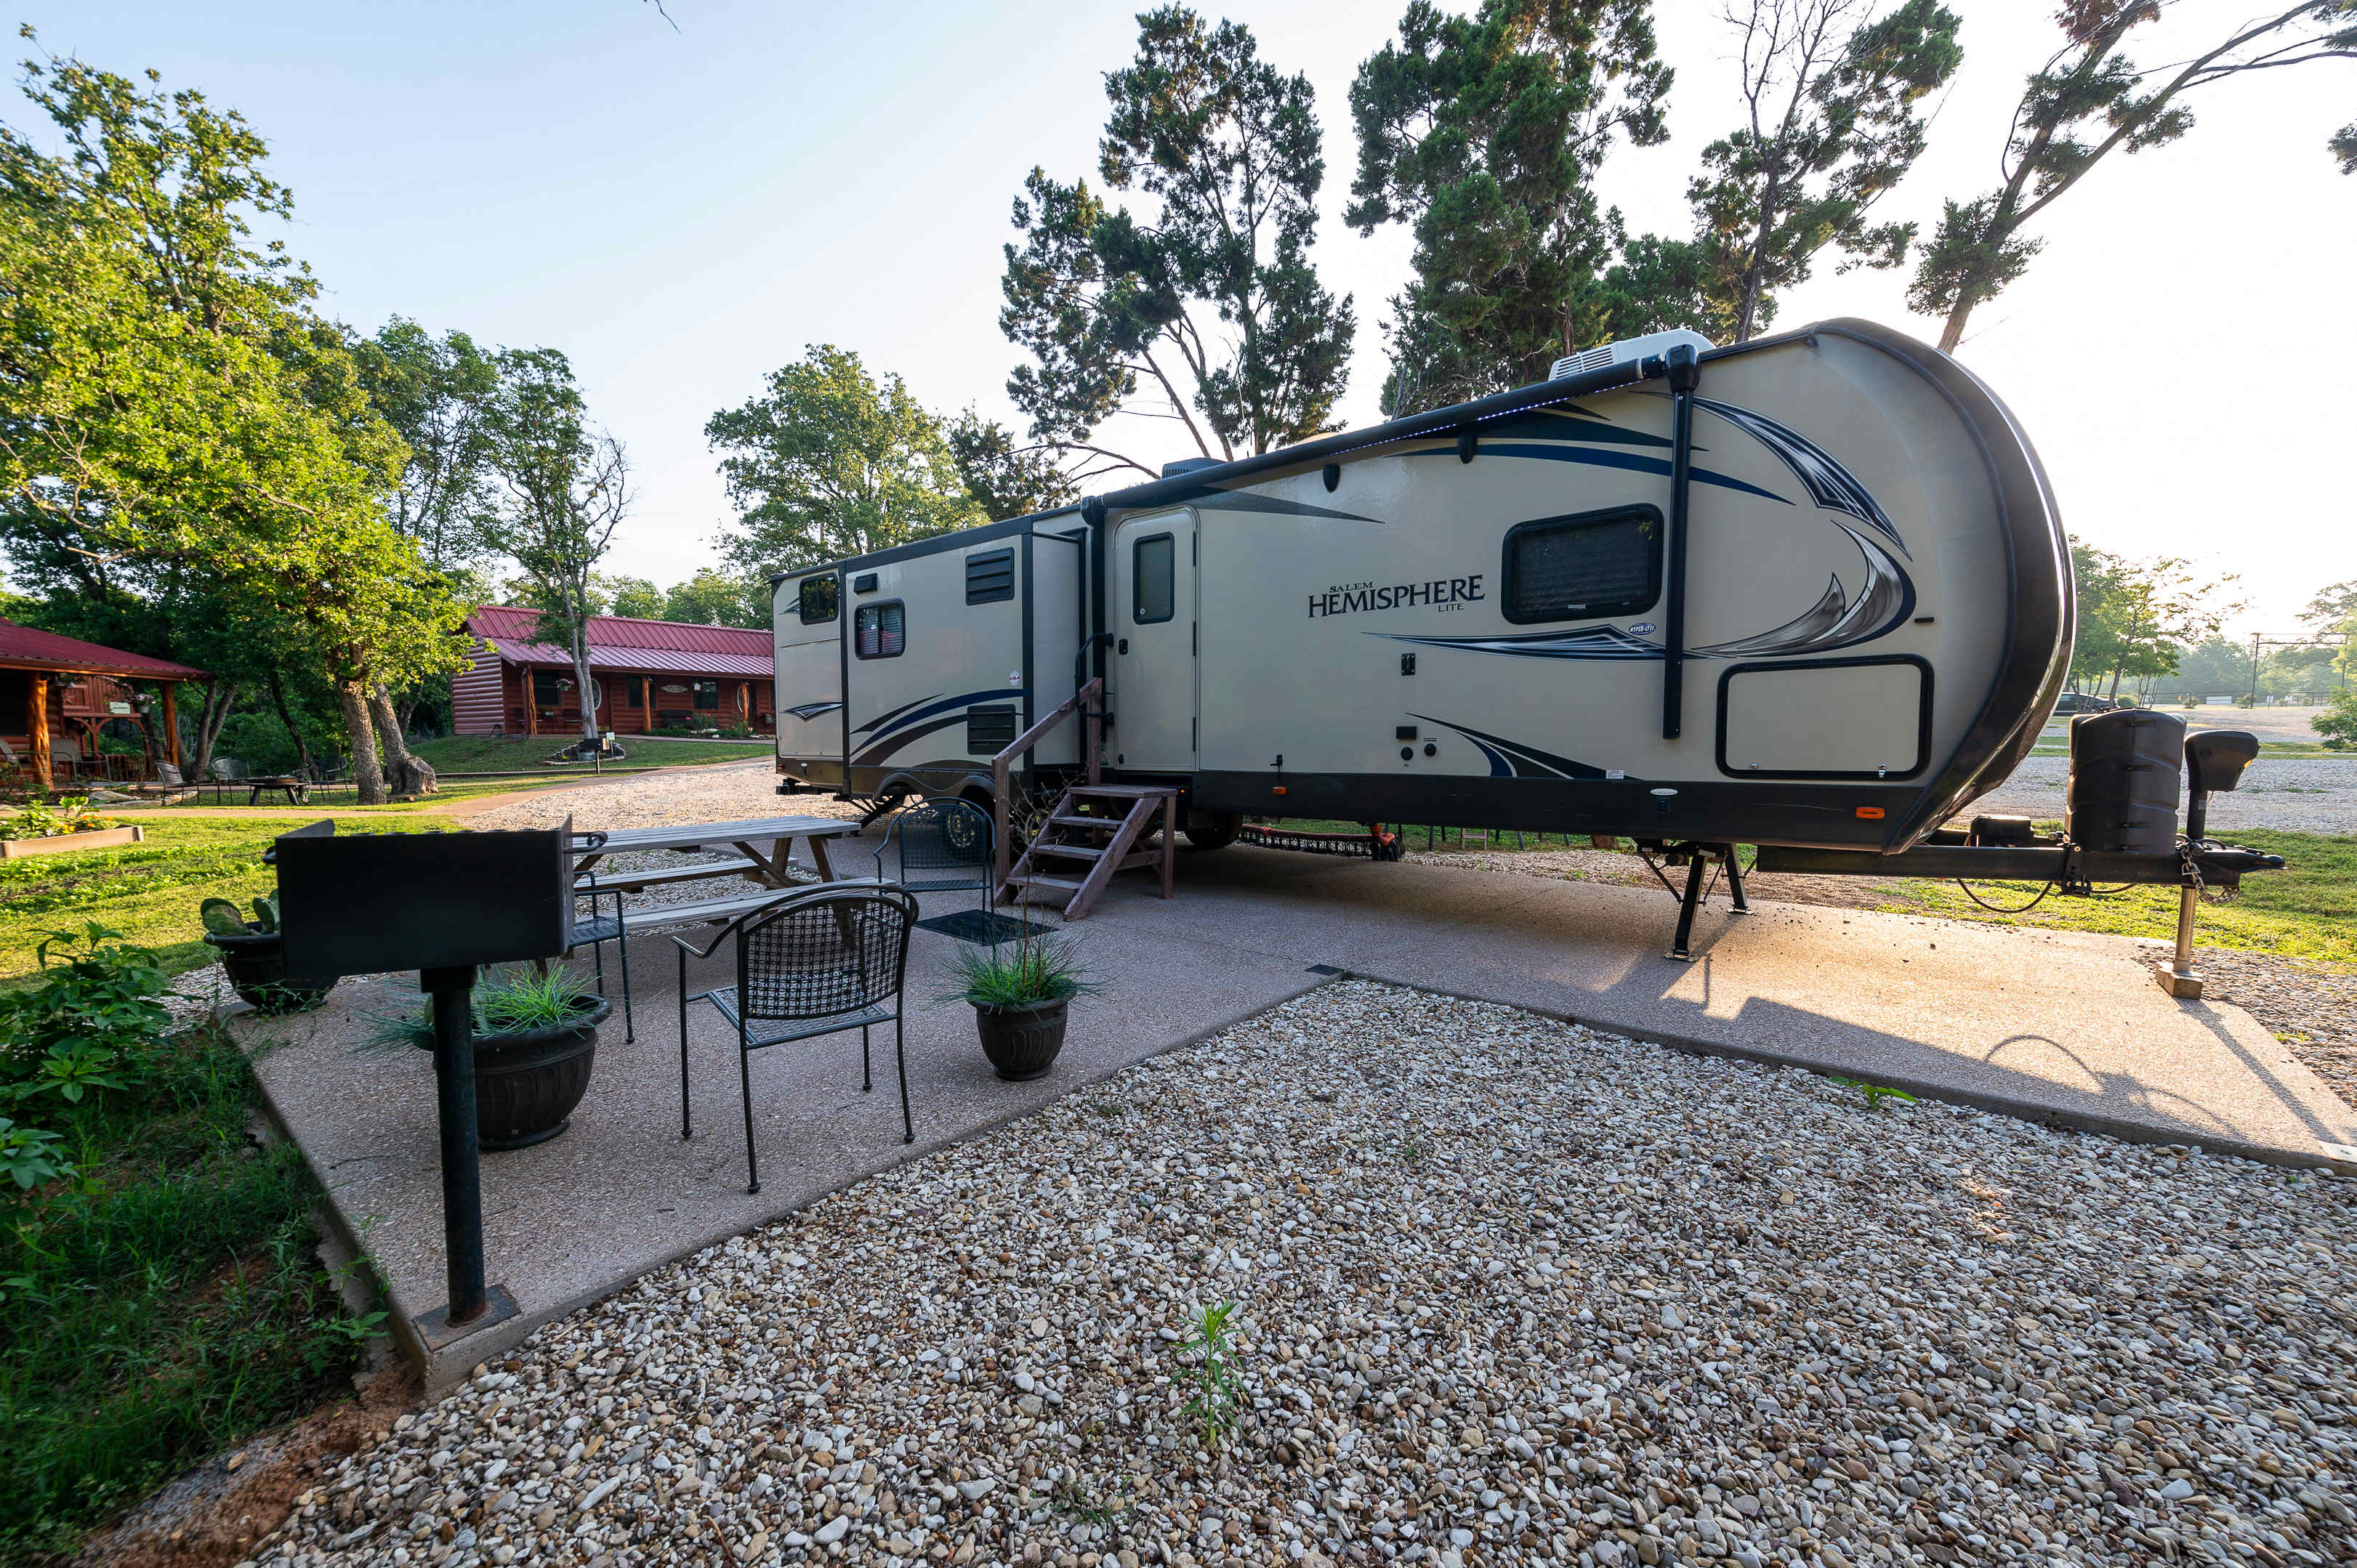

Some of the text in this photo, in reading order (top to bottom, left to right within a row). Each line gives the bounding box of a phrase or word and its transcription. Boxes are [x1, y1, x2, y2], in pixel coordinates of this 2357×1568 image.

[1329, 581, 1374, 593] SALEM
[1308, 574, 1486, 618] HEMISPHERE
[1438, 603, 1464, 612] LITE
